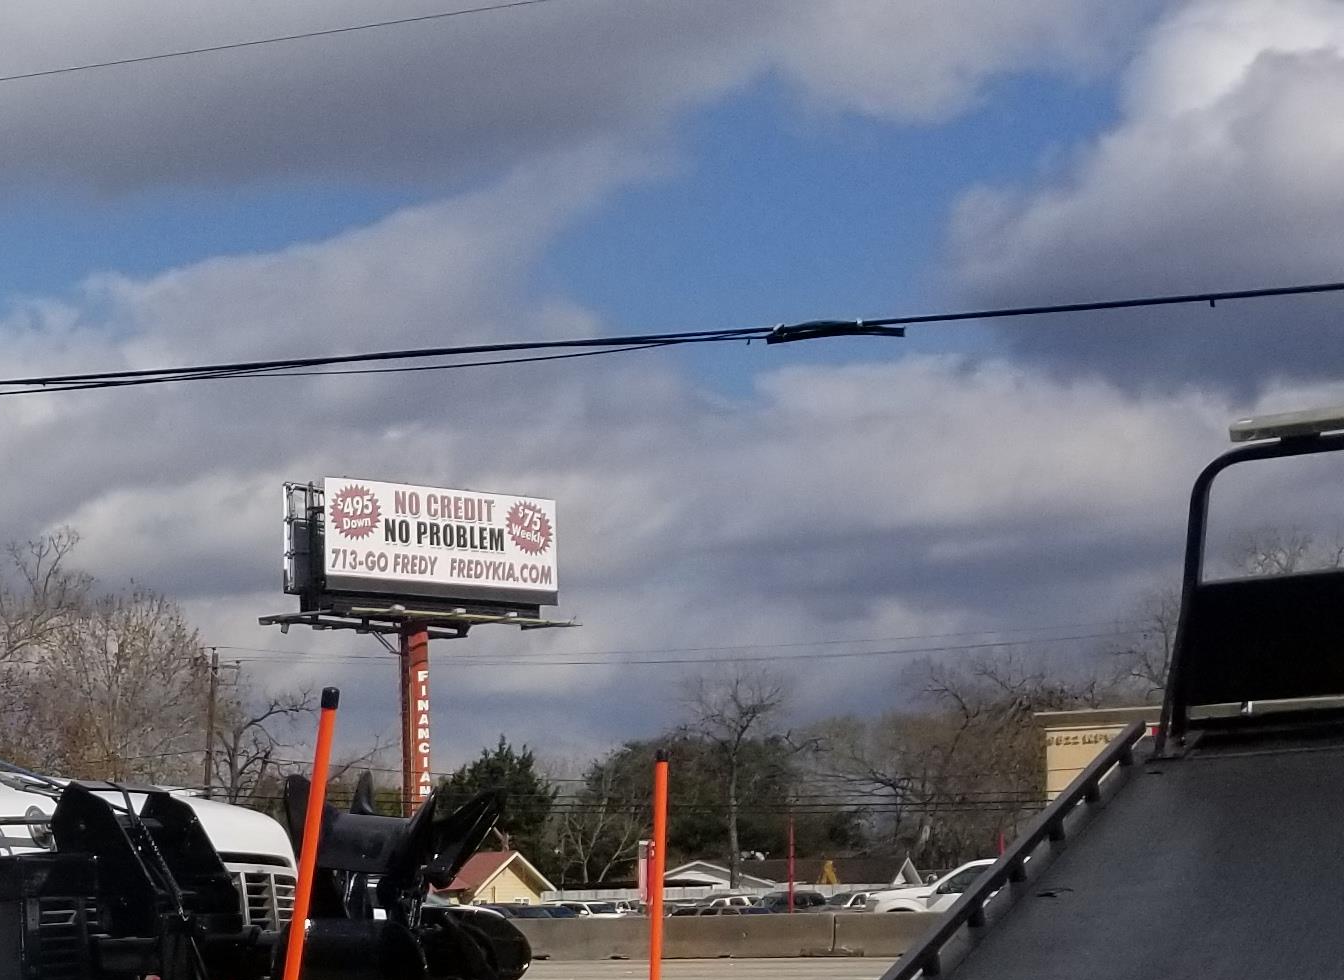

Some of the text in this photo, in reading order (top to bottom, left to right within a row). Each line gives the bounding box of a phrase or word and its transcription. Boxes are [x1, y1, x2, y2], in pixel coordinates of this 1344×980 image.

[337, 494, 373, 516] $495
[394, 490, 496, 523] NO CREDIT
[518, 505, 542, 531] $75
[342, 517, 372, 530] Down
[384, 517, 505, 552] NO PROBLEM
[511, 522, 546, 548] Weekly
[331, 548, 553, 585] 713-GO FREDY FREDYKIA.COM
